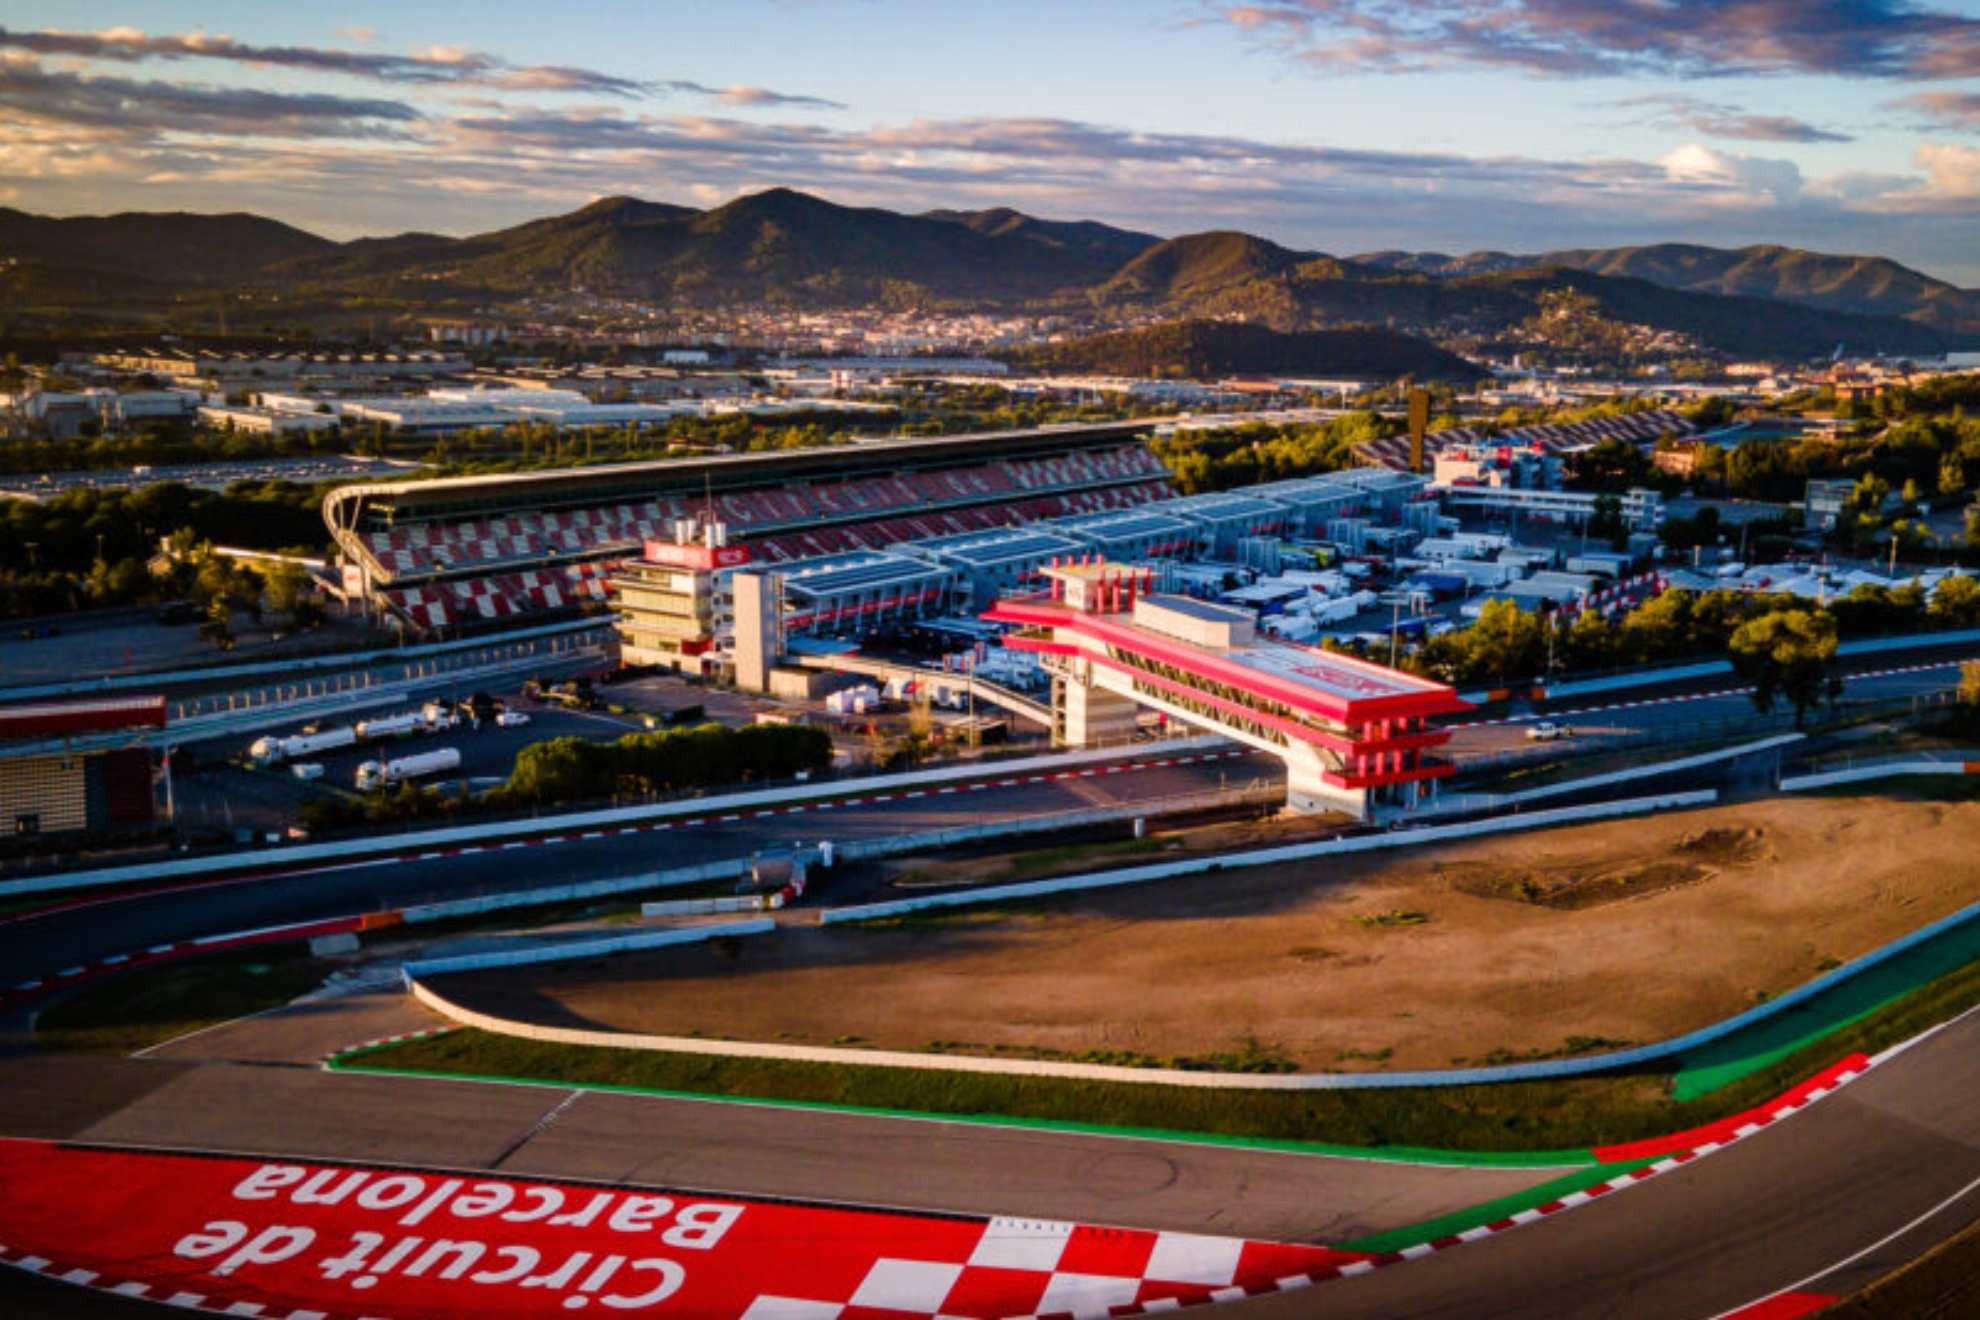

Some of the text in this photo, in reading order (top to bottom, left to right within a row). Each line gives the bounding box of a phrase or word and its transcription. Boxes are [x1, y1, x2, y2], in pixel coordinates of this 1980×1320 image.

[231, 1164, 746, 1250] Barcelona
[173, 1221, 686, 1310] Circuit de
